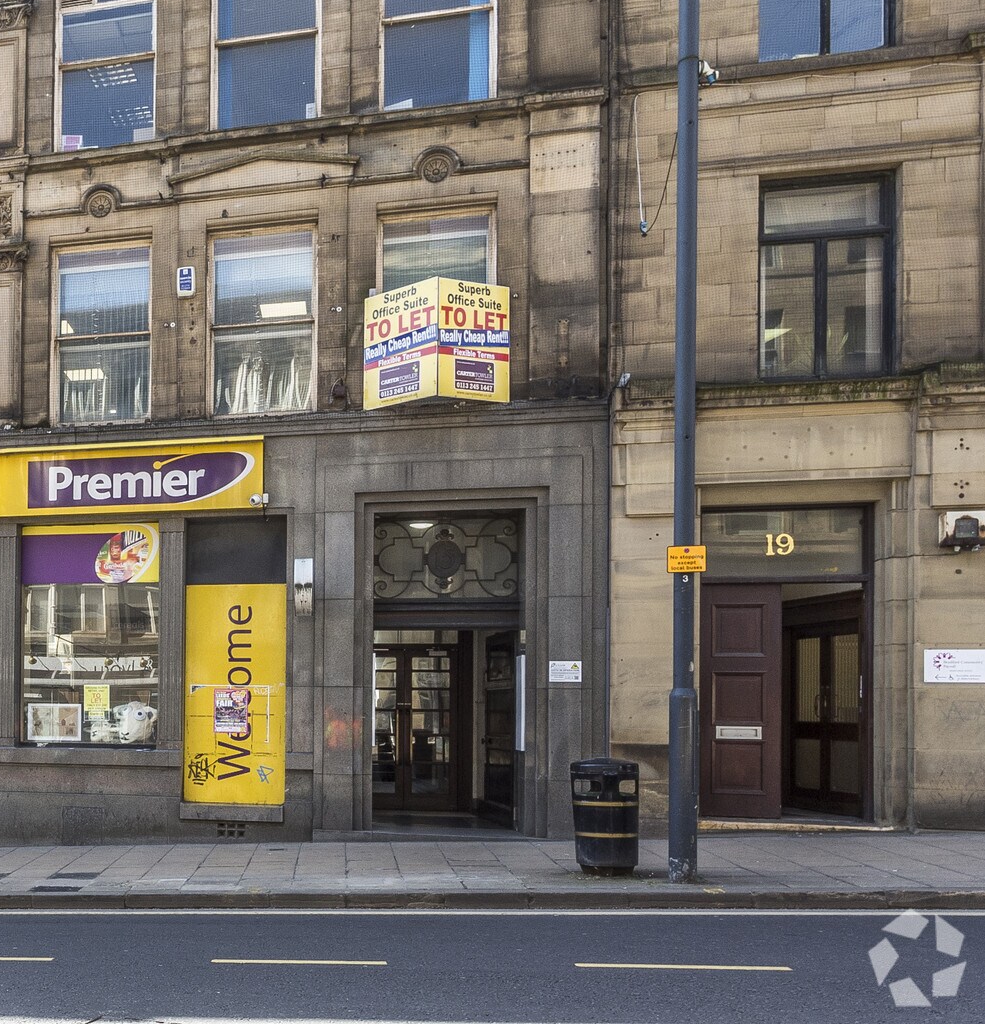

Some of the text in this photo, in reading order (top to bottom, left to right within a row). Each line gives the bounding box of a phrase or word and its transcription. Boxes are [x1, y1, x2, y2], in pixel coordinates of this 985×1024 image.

[384, 286, 417, 304] Superb
[458, 282, 491, 296] Superb
[372, 297, 428, 320] Office Suite
[448, 294, 502, 311] Office Suite
[366, 305, 435, 341] TO LET
[441, 305, 507, 331] TO LET
[365, 324, 436, 360] Really Cheap Rent!!!
[440, 329, 508, 346] Really Cheap Rent!!!
[378, 351, 421, 367] Flexible Terms
[453, 348, 495, 360] Flexible Terms
[380, 389, 393, 397] 0113
[394, 387, 404, 395] 245
[48, 461, 206, 501] Premier
[765, 533, 795, 556] 19
[682, 574, 689, 583] 3
